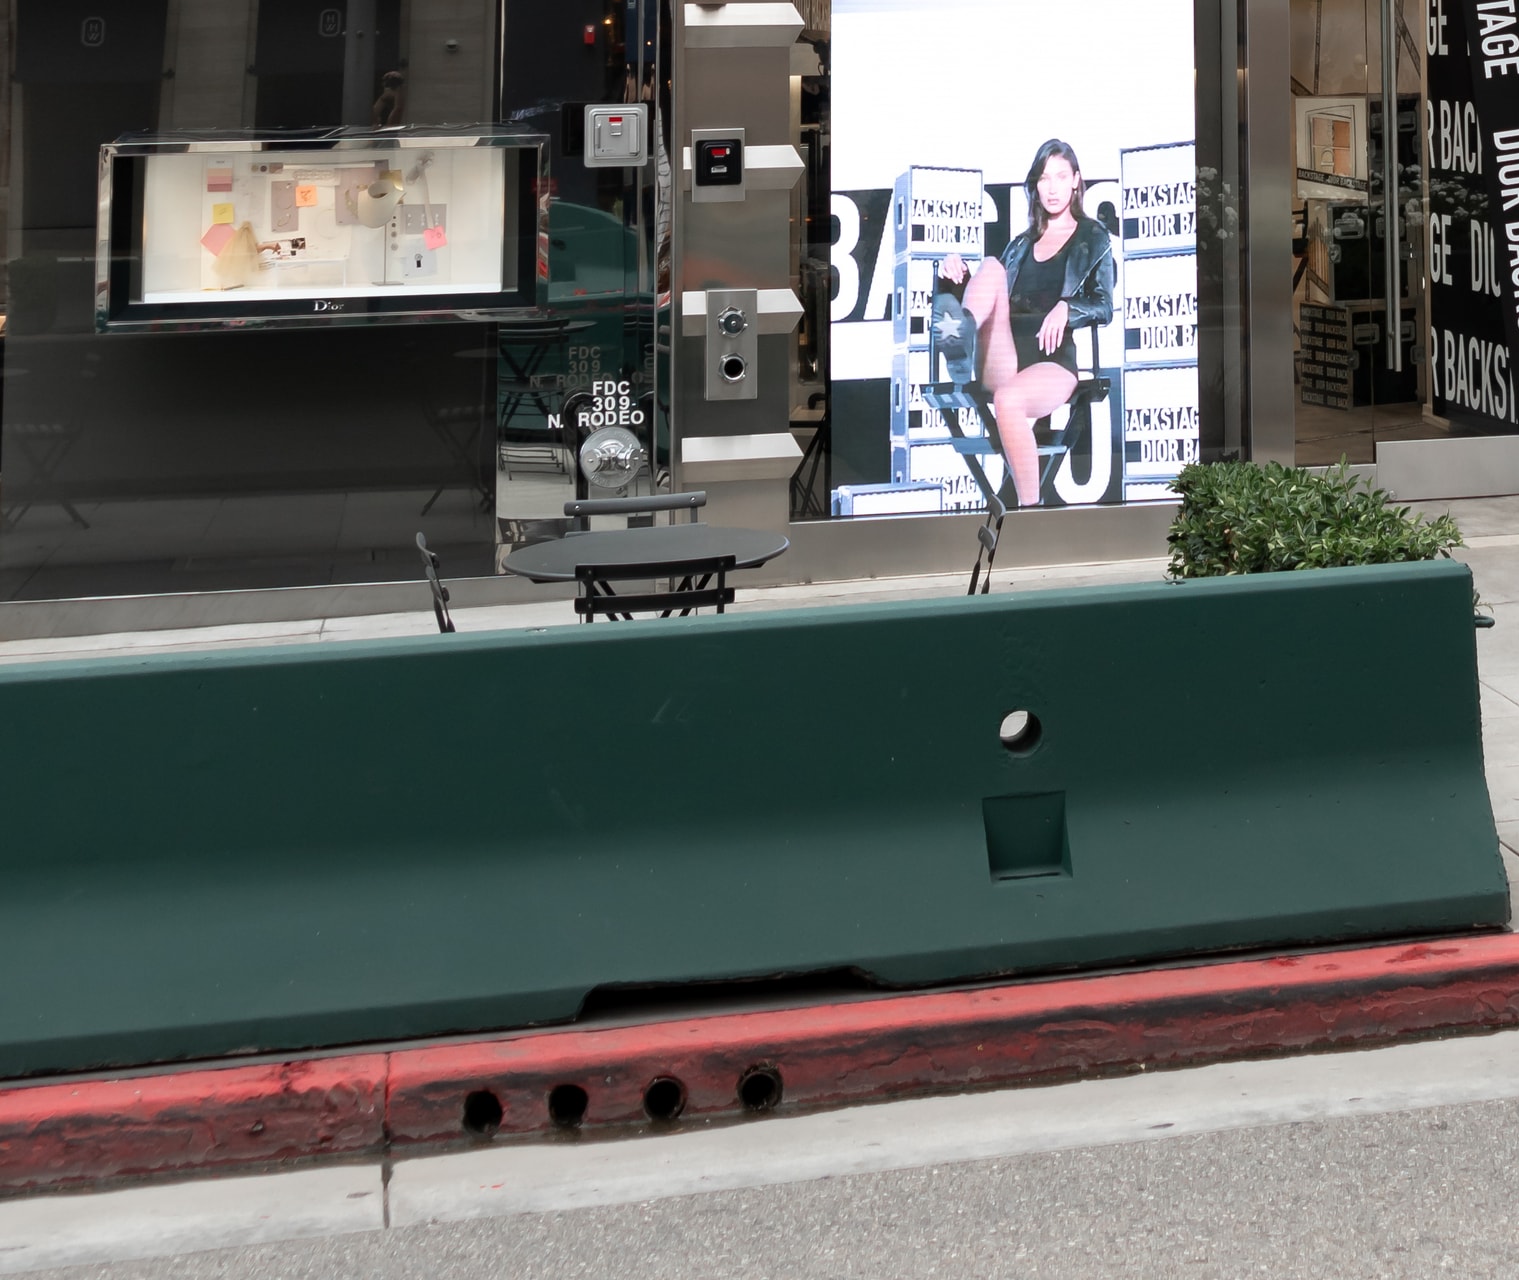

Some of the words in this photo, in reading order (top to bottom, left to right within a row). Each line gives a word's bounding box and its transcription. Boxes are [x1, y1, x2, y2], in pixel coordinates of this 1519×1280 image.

[924, 225, 957, 243] DIOR
[1139, 213, 1176, 239] DIOR
[313, 300, 345, 312] Dior
[1140, 325, 1179, 349] DIOR
[592, 381, 630, 396] FDC
[547, 414, 564, 429] N.
[578, 410, 645, 428] RODEO
[1140, 439, 1179, 463] DIOR
